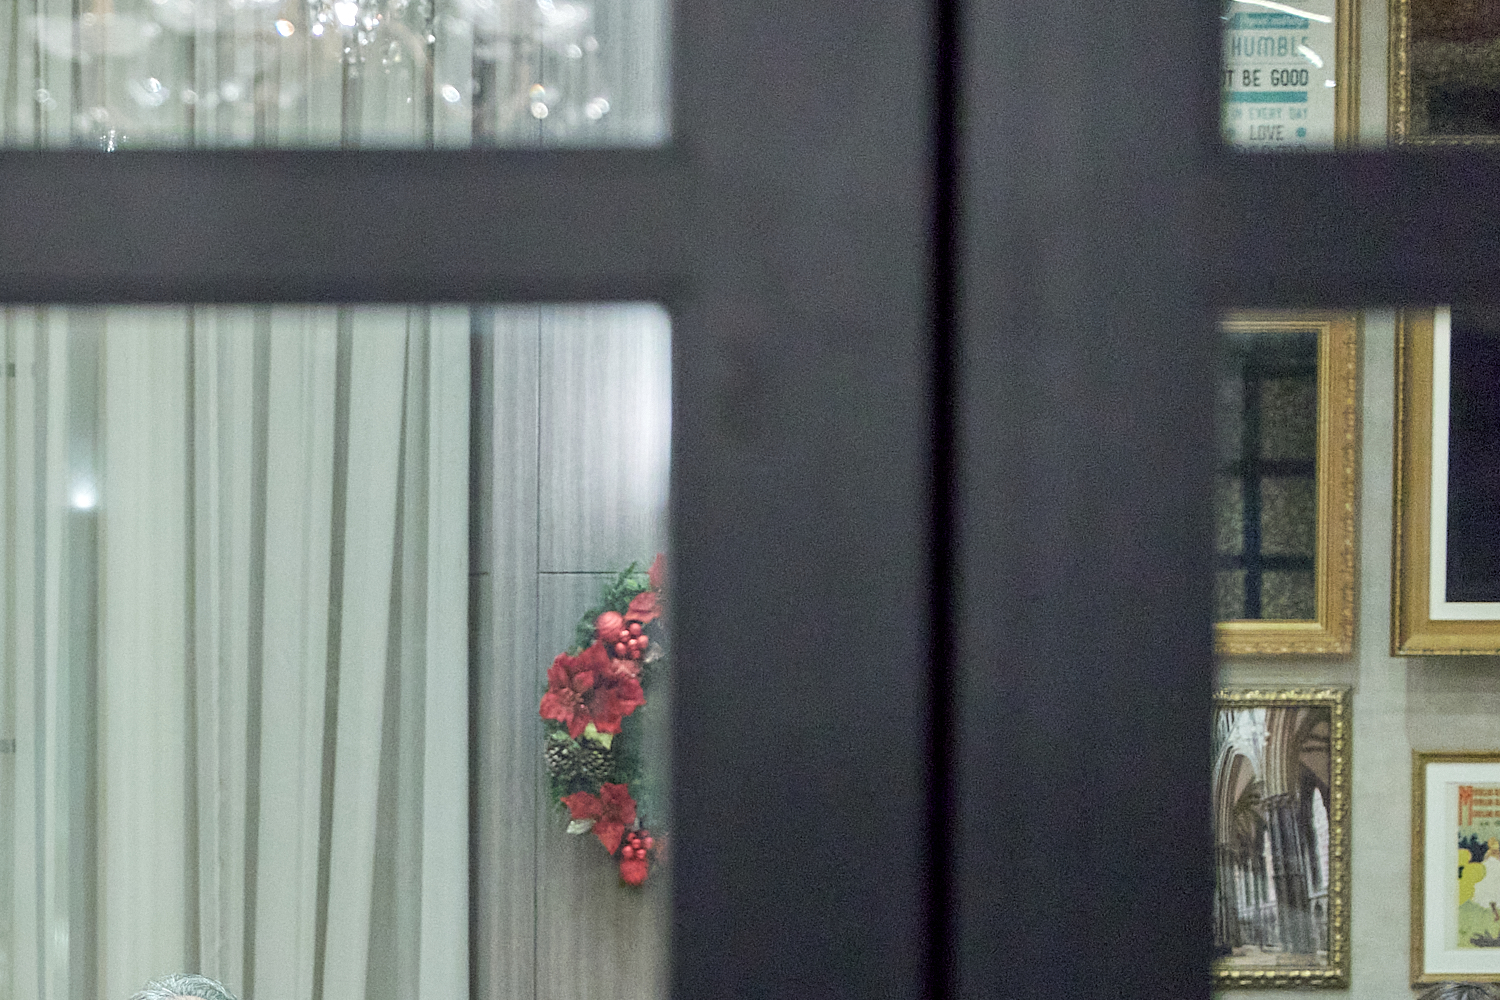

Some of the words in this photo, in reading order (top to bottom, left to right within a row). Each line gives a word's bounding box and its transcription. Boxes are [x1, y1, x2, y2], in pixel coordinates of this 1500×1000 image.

[1242, 69, 1261, 87] BE
[1270, 69, 1309, 87] GOOD
[1249, 124, 1285, 141] LOVE
